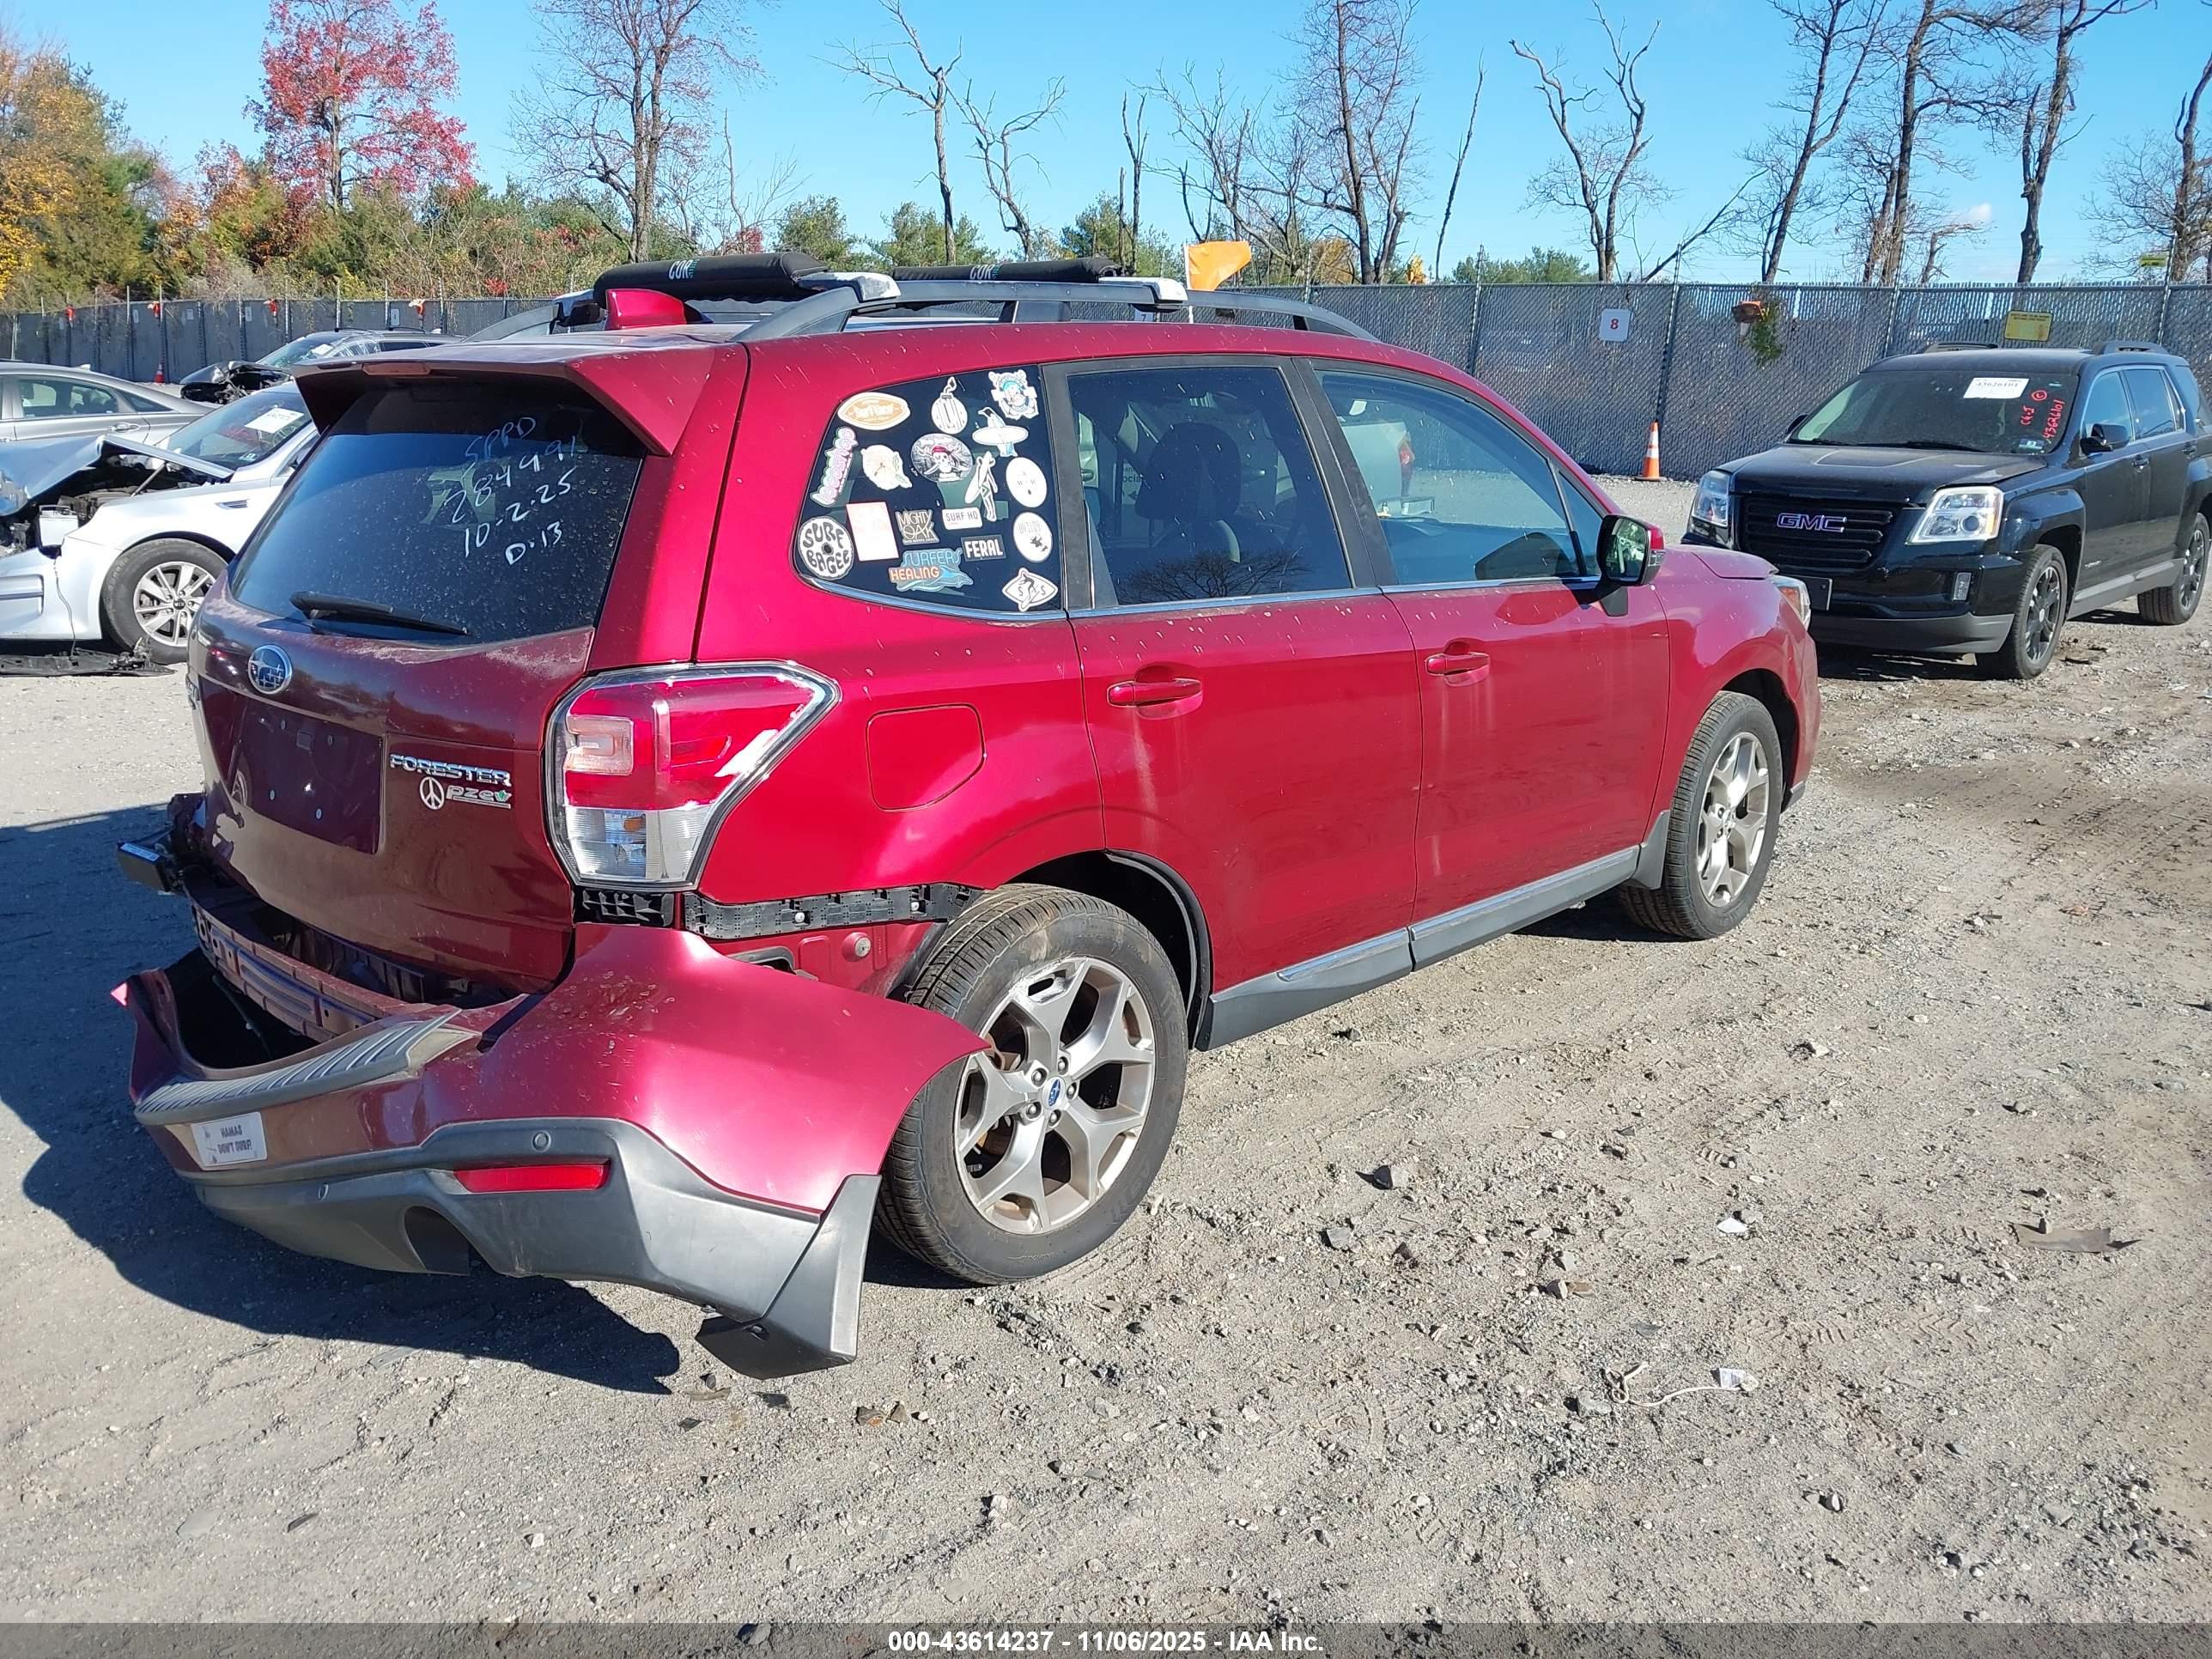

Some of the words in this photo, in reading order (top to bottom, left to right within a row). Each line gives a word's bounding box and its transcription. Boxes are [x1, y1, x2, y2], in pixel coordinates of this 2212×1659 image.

[1610, 318, 1620, 330] 8
[896, 510, 933, 532] MIGHTY
[945, 512, 965, 522] SURF
[1777, 513, 1848, 533] GMC
[802, 521, 844, 549] SURF
[902, 522, 938, 540] OAK
[902, 548, 963, 568] SURFERS
[963, 538, 1004, 558] FERAL
[389, 753, 513, 787] FORESTER
